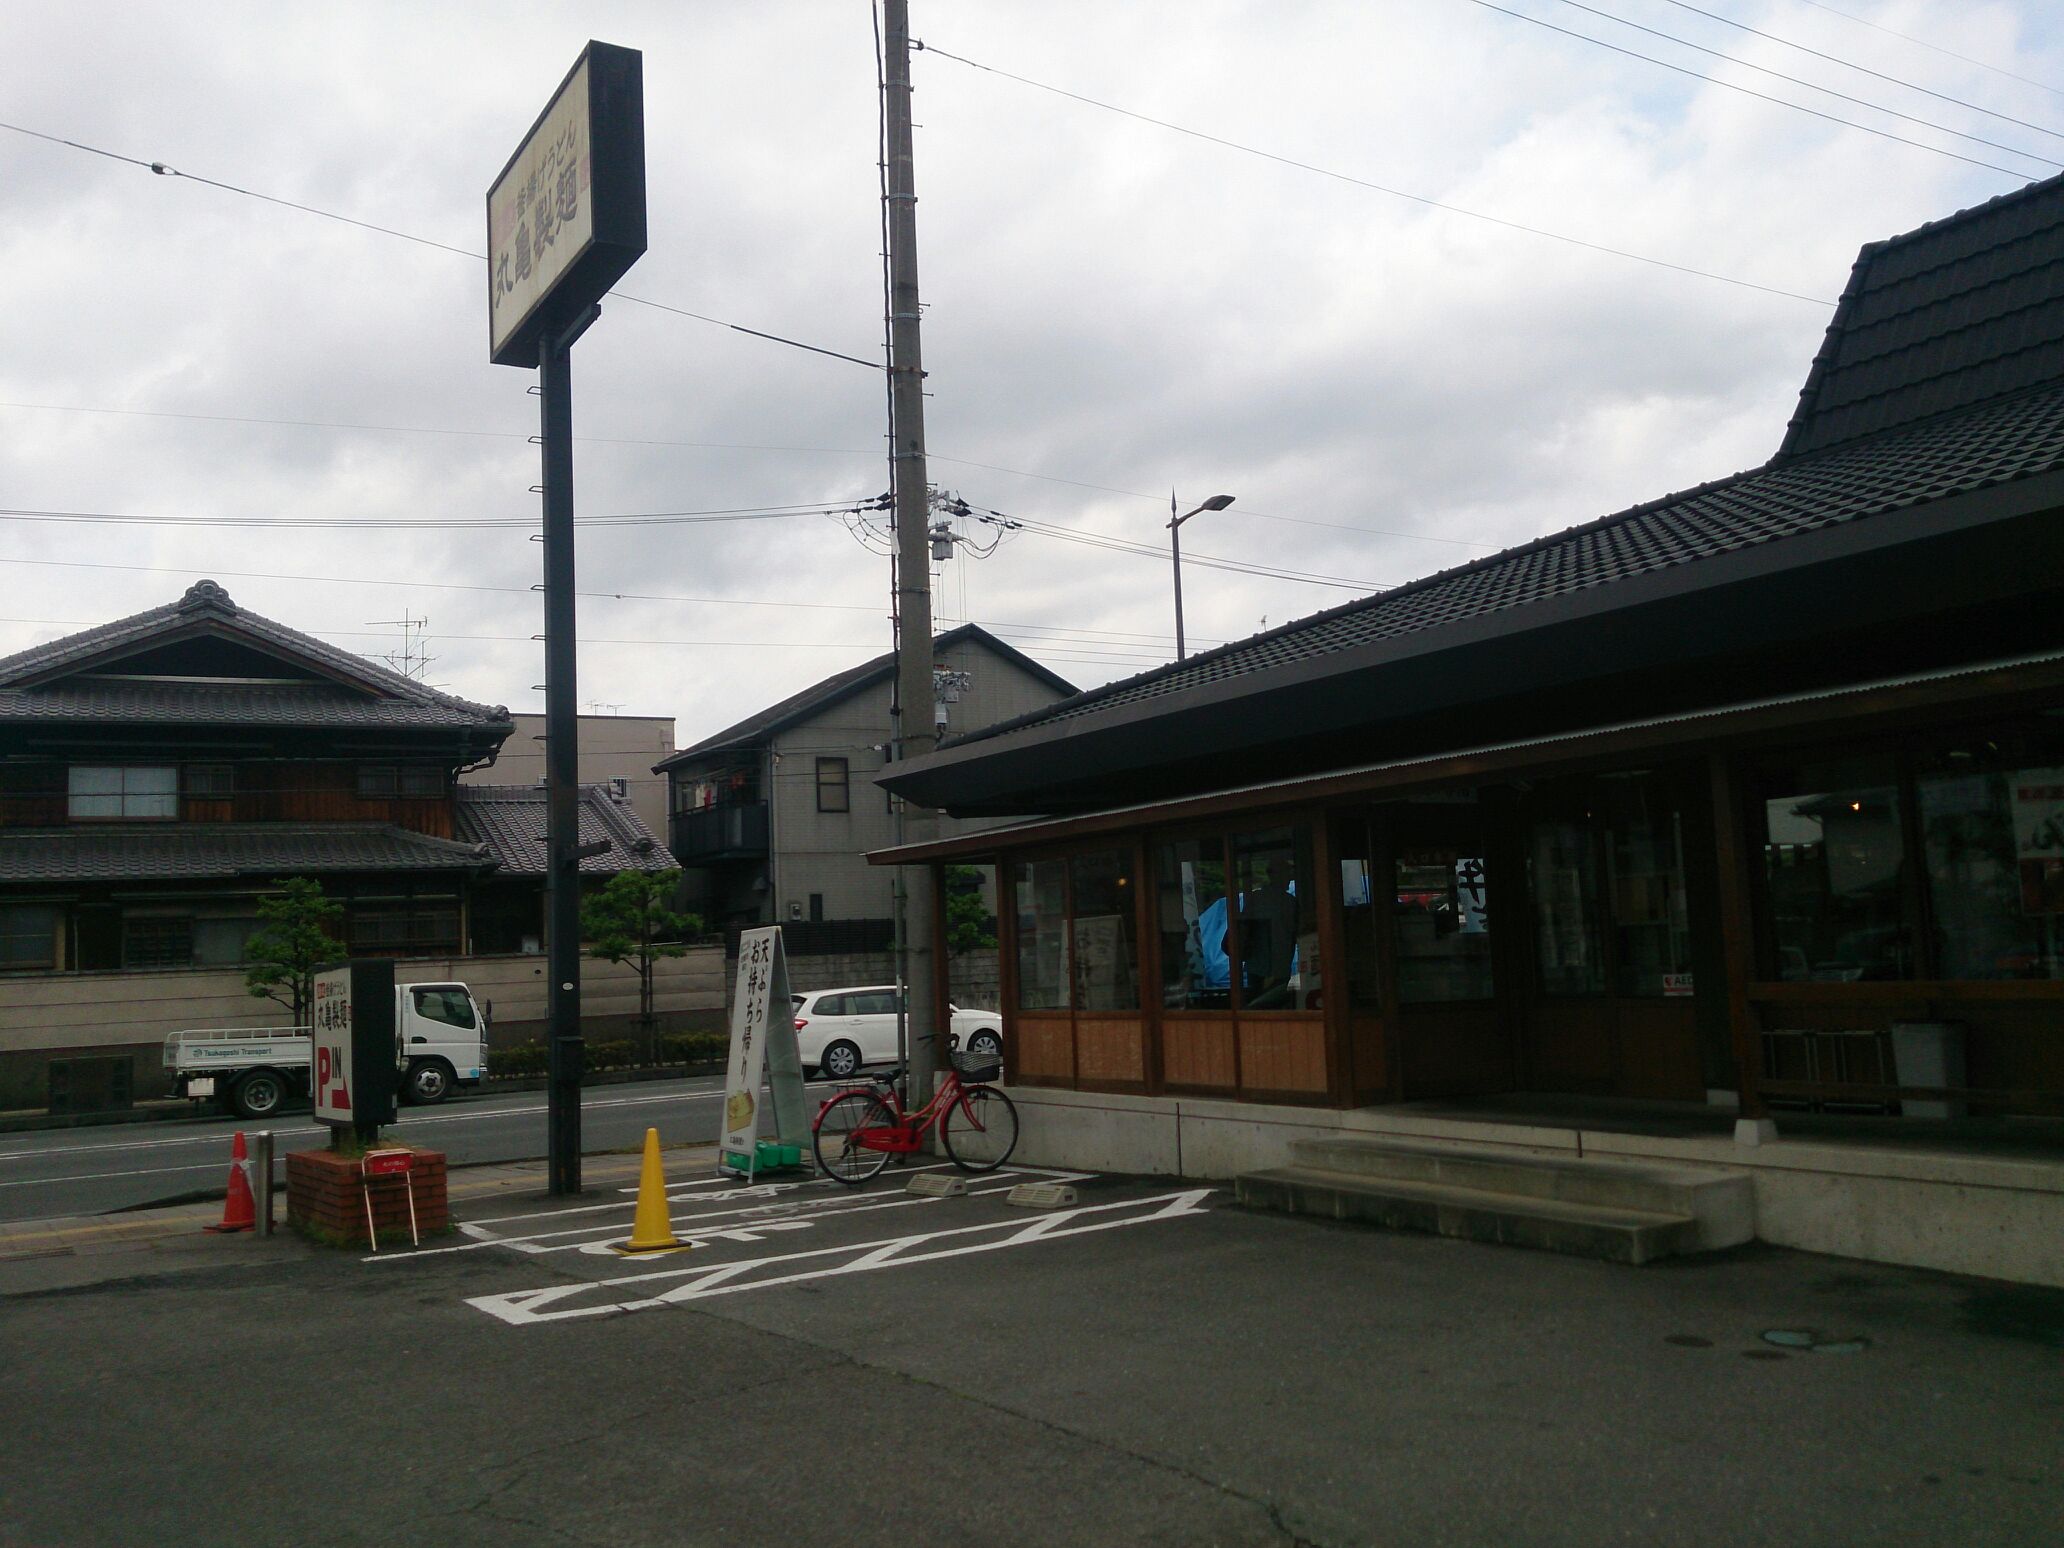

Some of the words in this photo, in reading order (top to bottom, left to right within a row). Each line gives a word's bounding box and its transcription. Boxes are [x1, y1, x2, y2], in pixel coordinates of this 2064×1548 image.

[496, 158, 577, 309] 丸亀製麺
[317, 999, 347, 1031] 丸亀製麺
[741, 940, 761, 1084] お持ち帰り
[756, 938, 769, 1024] 天ぷら
[204, 1048, 240, 1058] Tsukagoshi
[241, 1047, 272, 1056] Transport
[318, 1047, 331, 1108] P
[331, 1046, 342, 1079] IN
